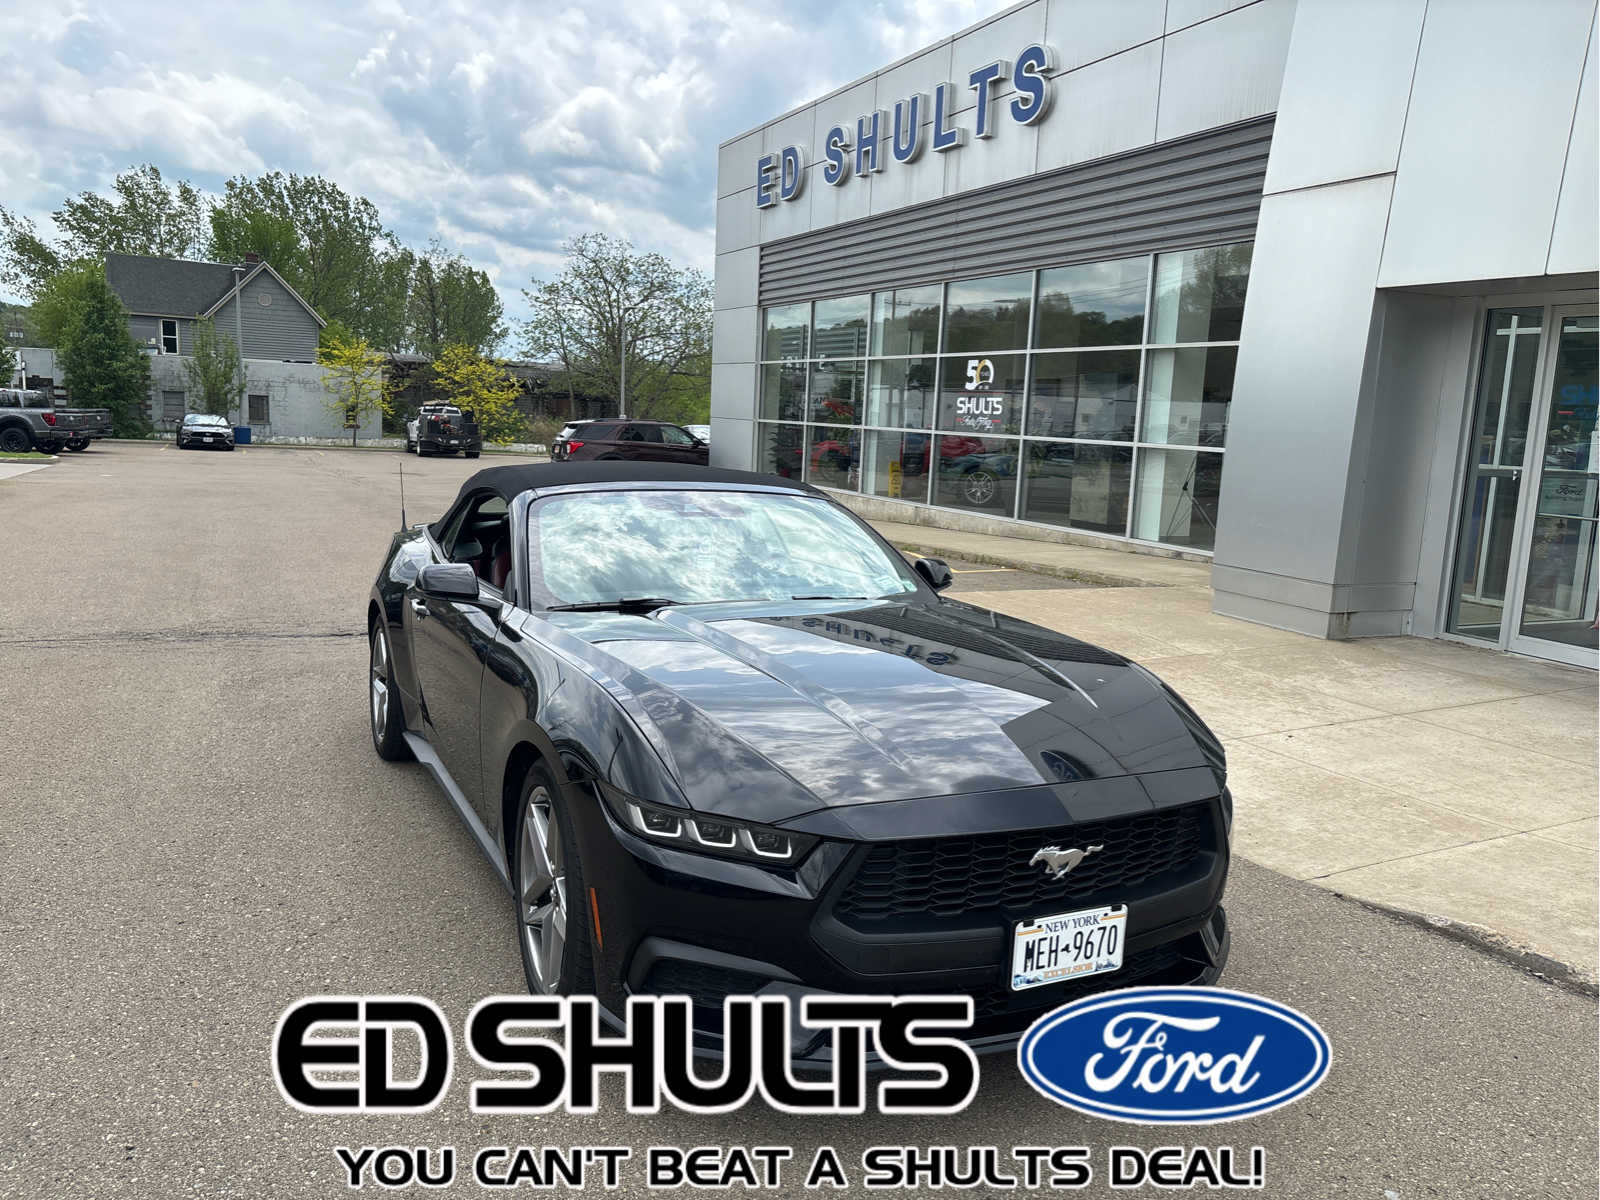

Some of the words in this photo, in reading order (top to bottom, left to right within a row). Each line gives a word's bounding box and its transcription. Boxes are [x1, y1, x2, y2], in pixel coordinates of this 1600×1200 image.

[756, 145, 806, 209] ED
[824, 43, 1055, 187] SHULTS
[956, 397, 1003, 414] SHULTS
[1045, 920, 1070, 934] NEW
[1073, 914, 1101, 929] YORK
[1023, 935, 1060, 973] MEH
[1073, 924, 1118, 962] 9670
